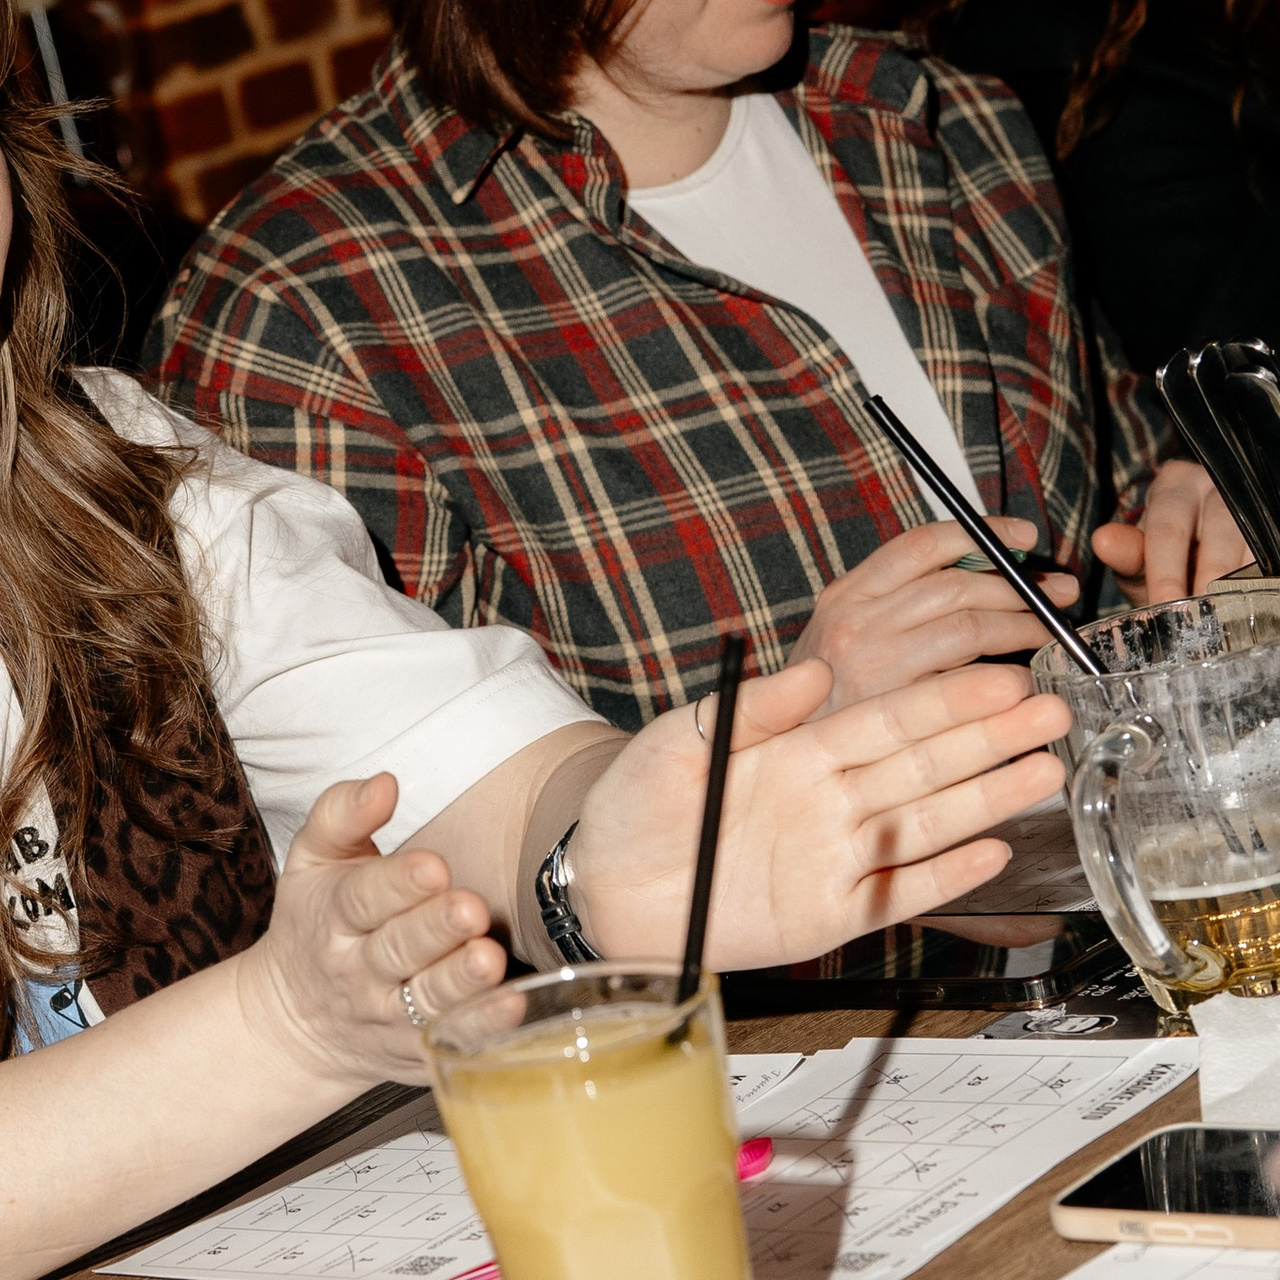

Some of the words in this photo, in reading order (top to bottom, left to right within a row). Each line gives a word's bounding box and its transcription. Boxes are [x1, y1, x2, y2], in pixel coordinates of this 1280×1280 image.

[967, 1076, 989, 1087] 29
[1048, 1078, 1071, 1089] 20
[1111, 1063, 1177, 1101] KARAOKE
[1081, 1101, 1125, 1120] LOTO
[356, 1209, 377, 1218] 17
[425, 1212, 447, 1221] 13
[207, 1246, 230, 1255] 18
[282, 1251, 305, 1260] 15
